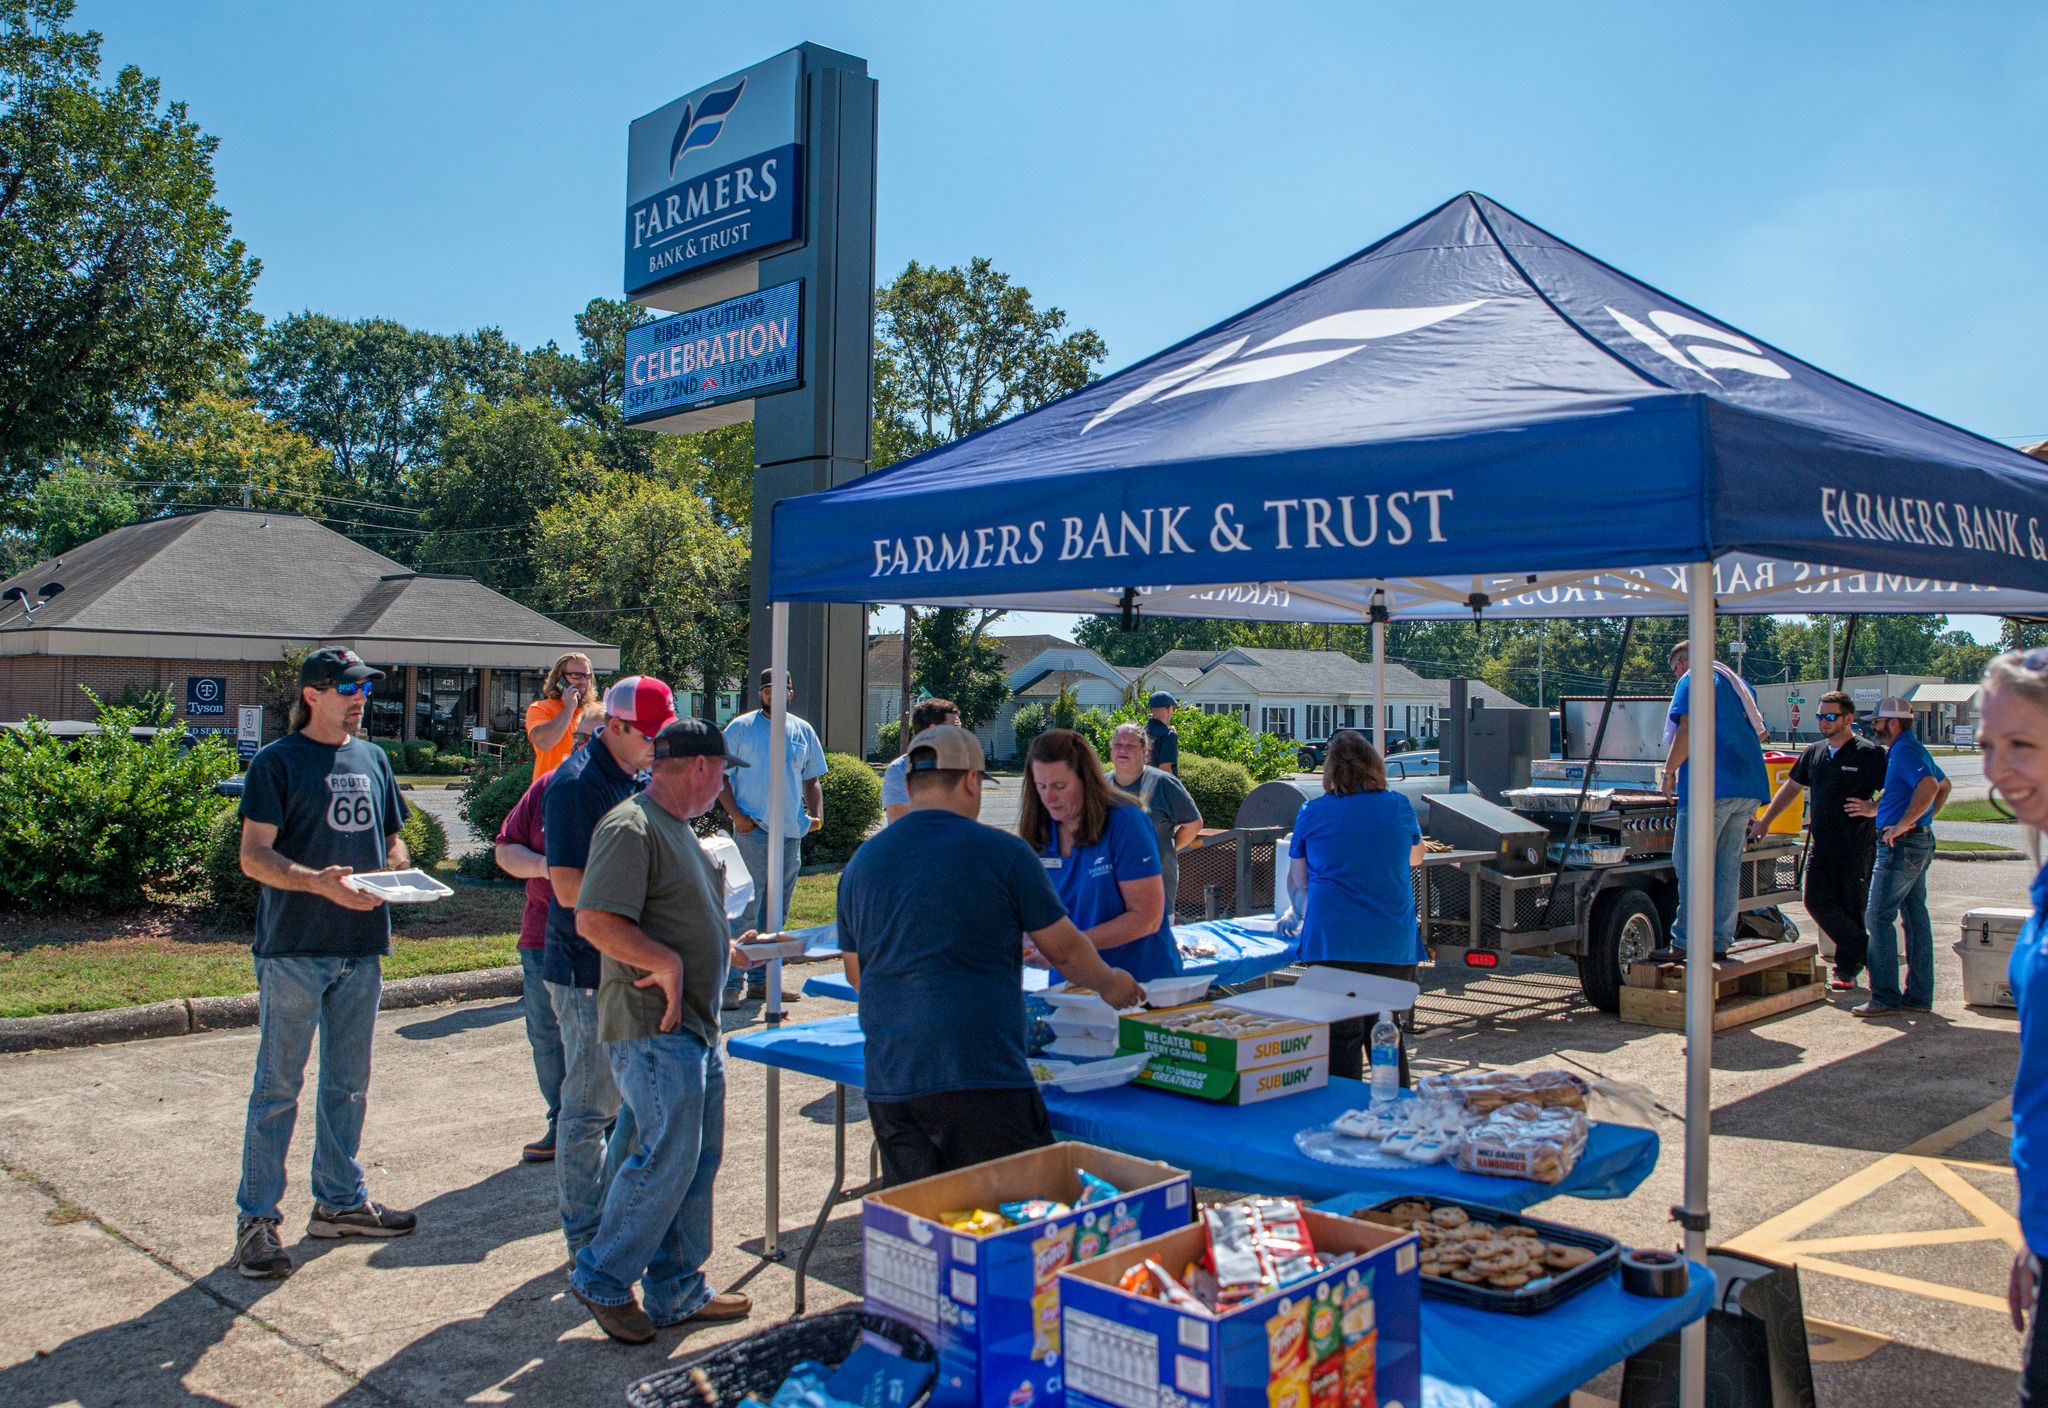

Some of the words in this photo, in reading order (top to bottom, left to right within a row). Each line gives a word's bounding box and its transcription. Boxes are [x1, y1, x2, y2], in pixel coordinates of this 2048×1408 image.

[633, 158, 778, 249] FARMERS
[649, 244, 684, 273] BANK
[685, 238, 698, 259] &
[700, 222, 751, 254] TRUST
[653, 318, 701, 344] RIBBON
[706, 297, 764, 329] CUTTING
[631, 316, 788, 386] CELEBRATION
[628, 386, 657, 409] SEPT.
[662, 377, 699, 400] 22ND
[720, 361, 759, 388] 11:00
[762, 354, 787, 377] AM
[869, 520, 1046, 578] FARMERS
[1058, 505, 1196, 562] BANK
[1210, 502, 1252, 553] &
[1263, 488, 1454, 549] TRUST
[1820, 486, 1954, 548] FARMERS
[1953, 503, 2026, 558] BANK
[2028, 517, 2048, 561] &
[188, 702, 224, 715] Tyson
[331, 778, 368, 788] ROUTE
[334, 796, 372, 825] 66
[1144, 1030, 1159, 1043] WE
[1160, 1034, 1191, 1050] CATER
[1144, 1042, 1169, 1056] EVERY
[1170, 1047, 1207, 1063] CRAVING
[1253, 1034, 1313, 1060] SUBWAY
[1152, 1071, 1204, 1090] GREATNESS
[1166, 1065, 1175, 1073] TO
[1175, 1069, 1208, 1081] UNWRAP
[1256, 1066, 1313, 1093] SUBWAY
[1476, 1157, 1528, 1173] HAMBURGER
